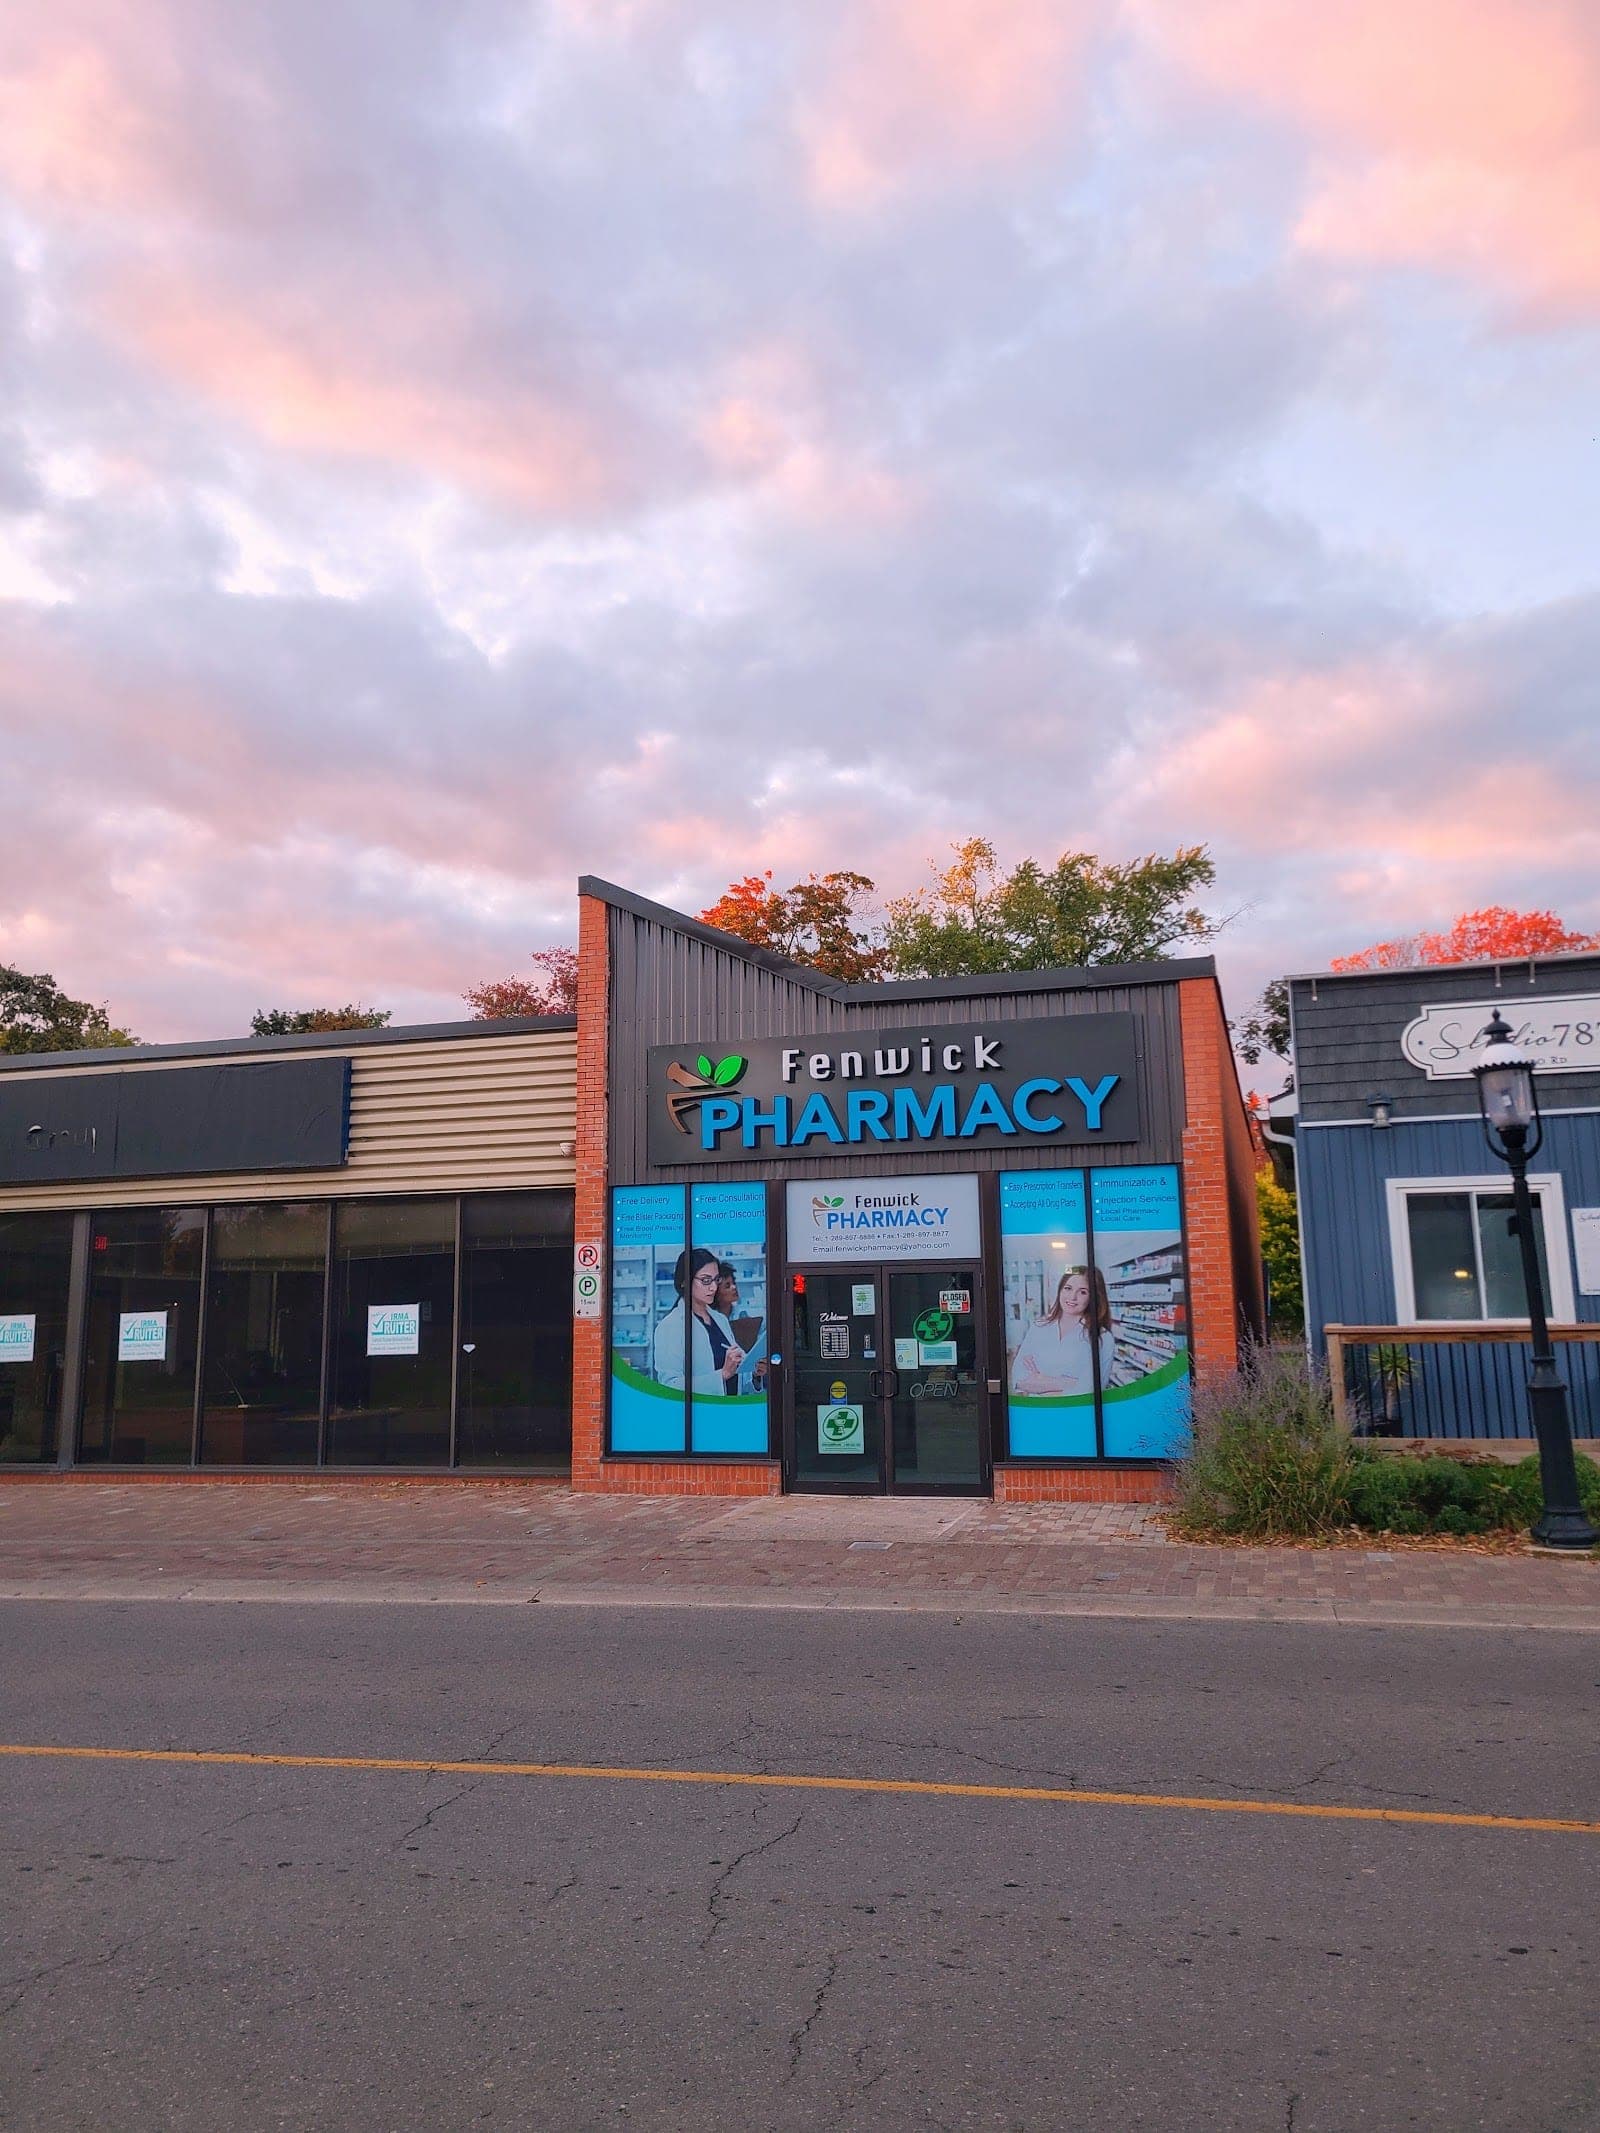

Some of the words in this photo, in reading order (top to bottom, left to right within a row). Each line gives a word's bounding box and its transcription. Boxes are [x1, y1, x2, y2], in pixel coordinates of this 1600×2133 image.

[781, 1035, 1001, 1081] Fenwick
[701, 1074, 1121, 1150] PHARMACY
[1008, 1182, 1023, 1193] Easy
[1100, 1177, 1157, 1188] Immunization
[1159, 1176, 1167, 1186] &
[621, 1197, 638, 1206] Free
[640, 1196, 670, 1206] Delivery
[700, 1195, 716, 1204] Free
[718, 1193, 764, 1203] Consultation
[855, 1193, 920, 1209] Fenwick
[1101, 1196, 1137, 1206] Injection
[1139, 1195, 1177, 1204] Services
[701, 1211, 727, 1220] Senior
[729, 1209, 765, 1219] Discount
[827, 1207, 949, 1230] PHARMACY
[942, 1293, 967, 1302] CLOSED
[391, 1312, 409, 1320] IRMA
[383, 1320, 416, 1335] RUITER
[4, 1330, 32, 1343] RUITER
[134, 1327, 164, 1341] RUITER
[909, 1382, 959, 1398] OPEN
